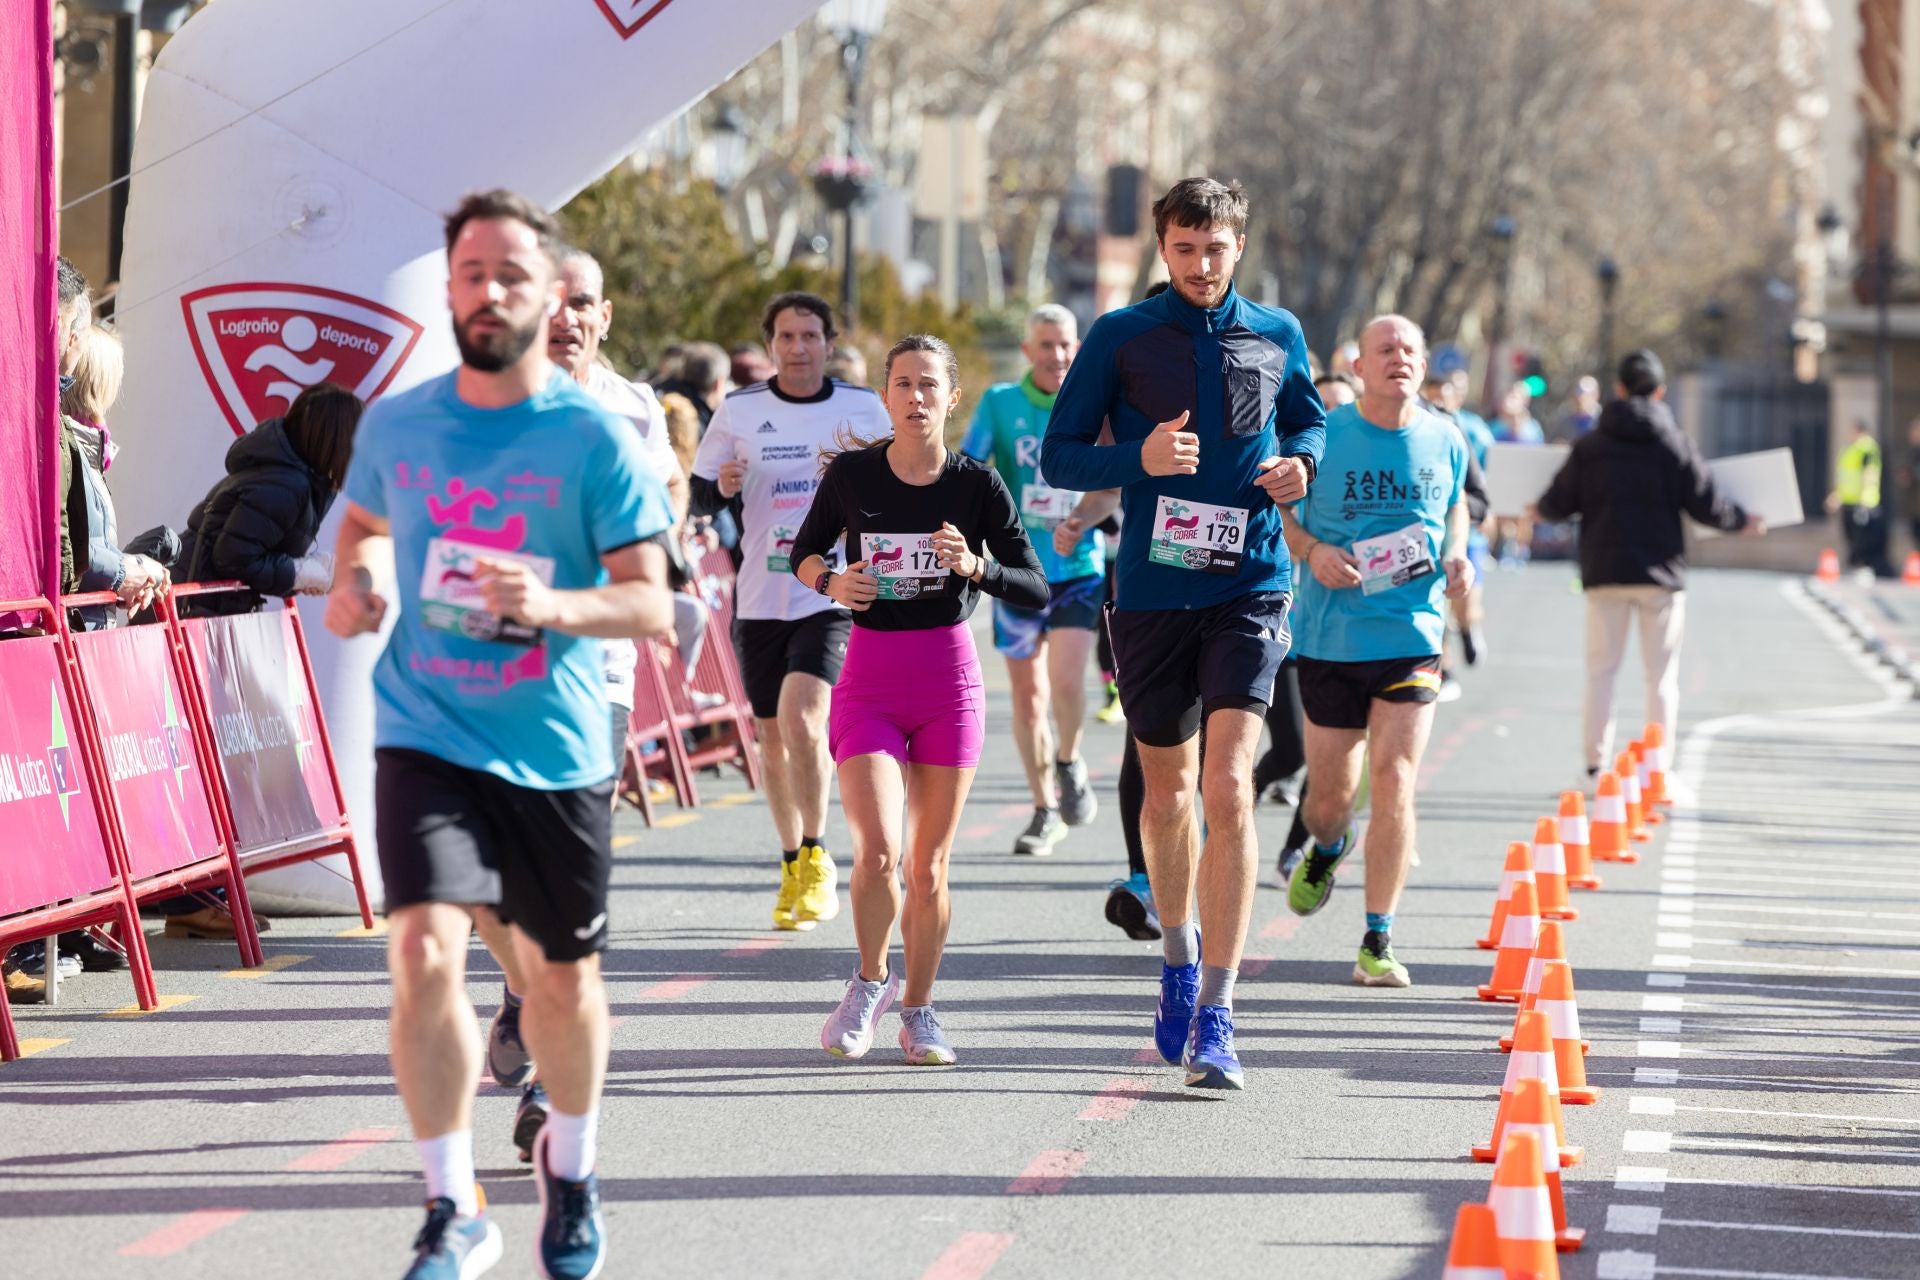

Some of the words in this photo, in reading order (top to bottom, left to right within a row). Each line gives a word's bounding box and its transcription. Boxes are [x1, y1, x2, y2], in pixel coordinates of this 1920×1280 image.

[219, 317, 279, 338] Logroño
[320, 325, 379, 355] deporte
[771, 479, 810, 497] ¡ÁNIMO
[1345, 470, 1394, 486] SAN
[1173, 529, 1199, 541] CORRE
[1206, 523, 1240, 545] 179
[910, 552, 944, 570] 178
[1397, 540, 1423, 564] 397
[872, 565, 881, 576] SE
[881, 560, 904, 575] CORRE
[215, 711, 263, 757] LABORAL
[105, 732, 148, 782] LABORAL
